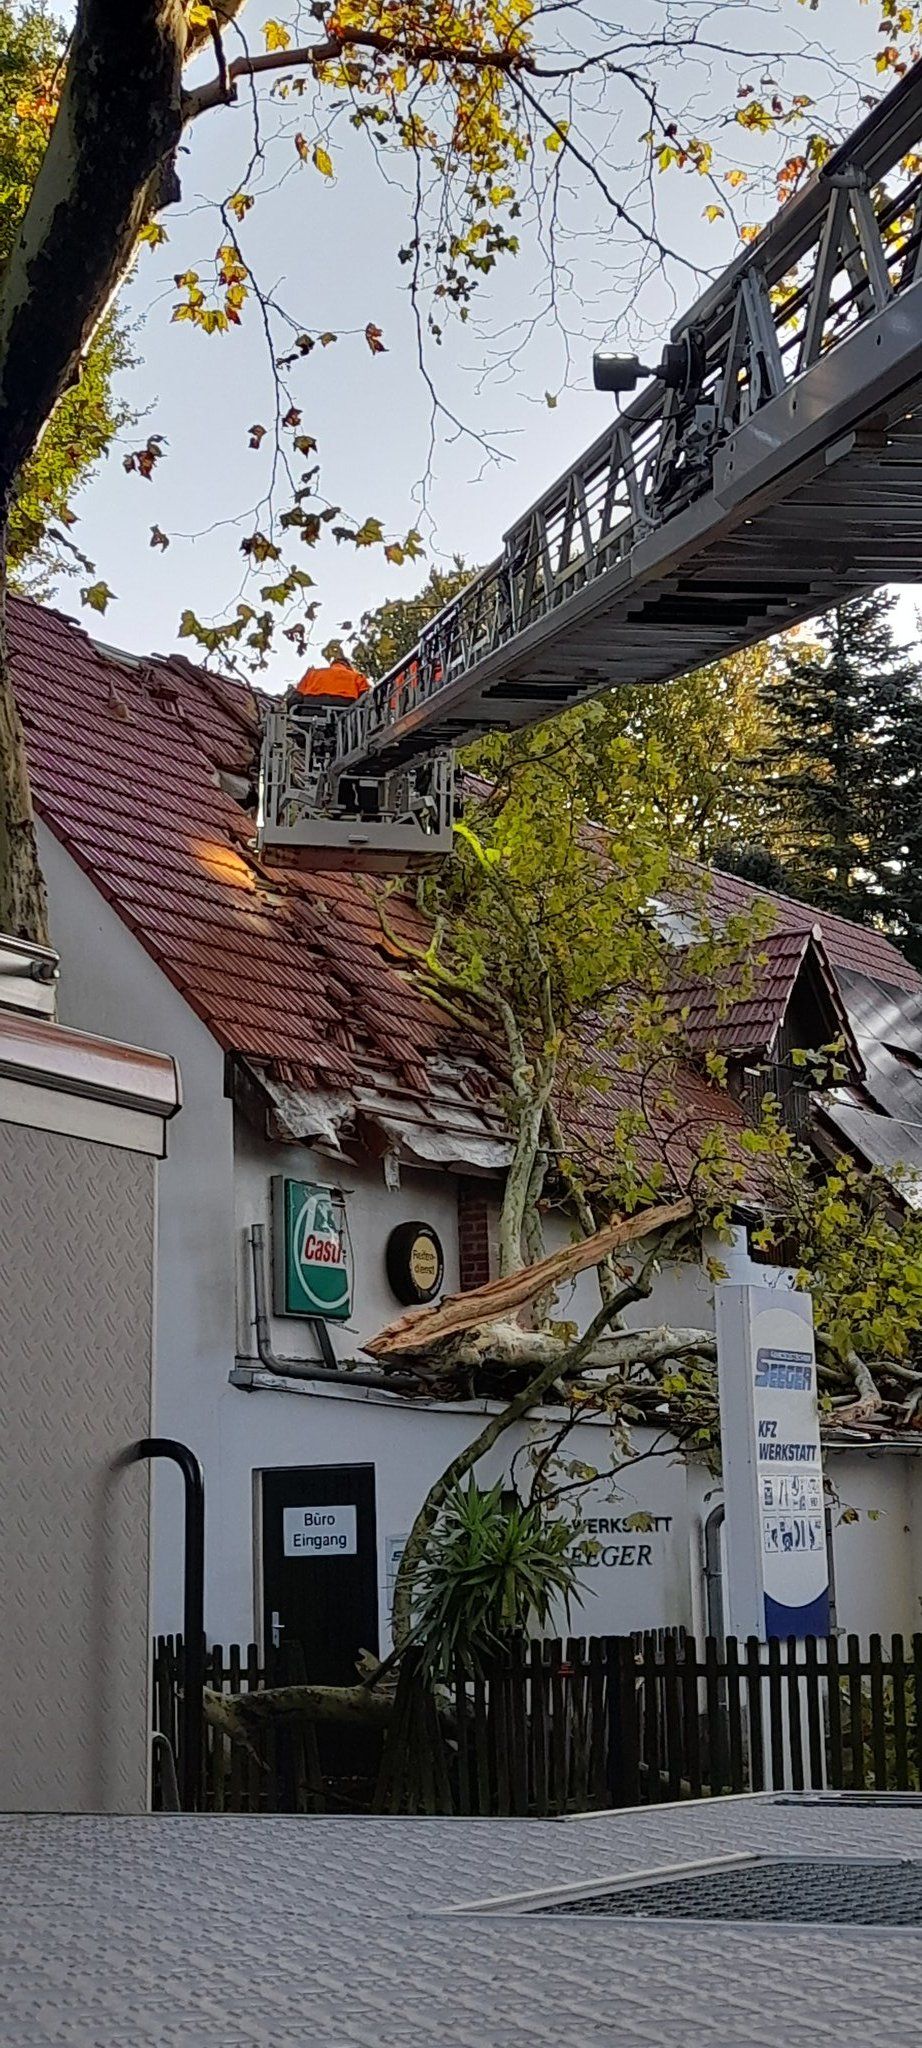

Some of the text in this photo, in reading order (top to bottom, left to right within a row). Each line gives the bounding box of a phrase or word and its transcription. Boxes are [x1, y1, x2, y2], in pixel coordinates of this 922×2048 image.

[755, 1349, 812, 1391] SEEGER
[758, 1420, 777, 1438] KFZ
[759, 1443, 817, 1461] WERKSTATT
[304, 1512, 336, 1526] Büro
[293, 1533, 347, 1549] Eingang
